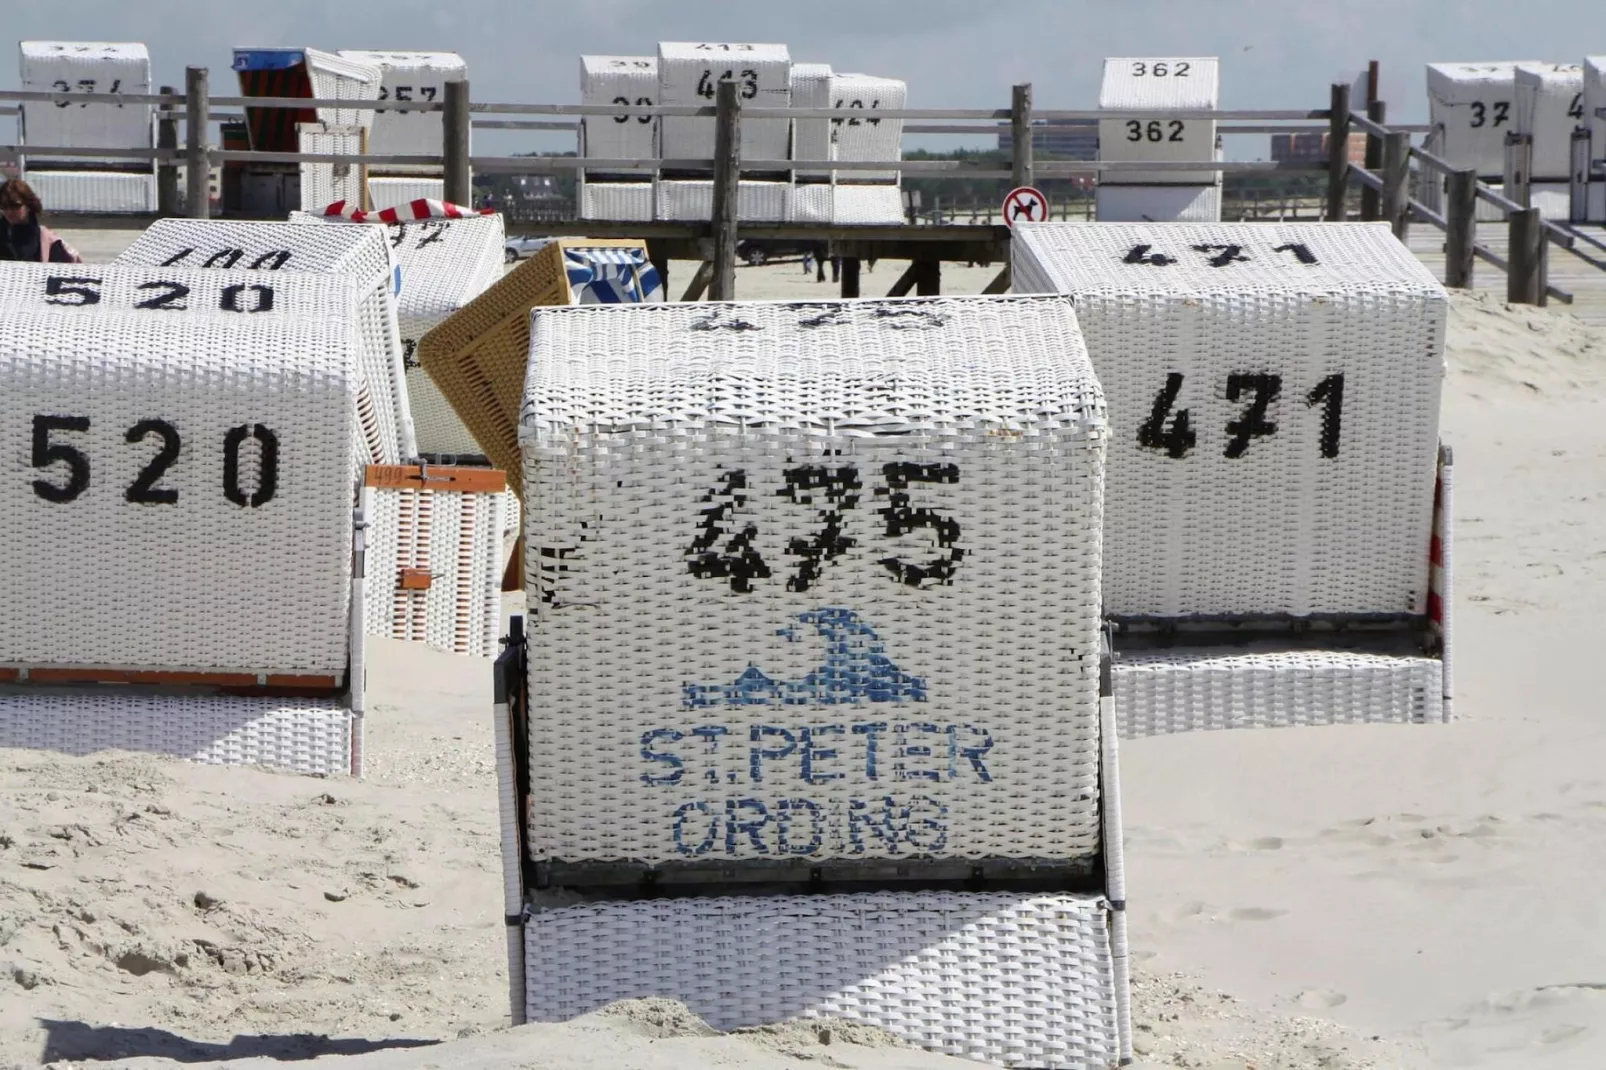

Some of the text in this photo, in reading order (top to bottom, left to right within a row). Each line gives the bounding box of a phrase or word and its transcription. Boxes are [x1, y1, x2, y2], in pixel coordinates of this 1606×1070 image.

[1131, 62, 1190, 77] 362
[1126, 120, 1185, 142] 362
[1122, 243, 1320, 268] 471
[45, 275, 274, 312] 520
[1137, 371, 1345, 459] 471
[32, 414, 279, 507] 520
[685, 461, 968, 592] 475
[671, 795, 950, 857] ORDING
